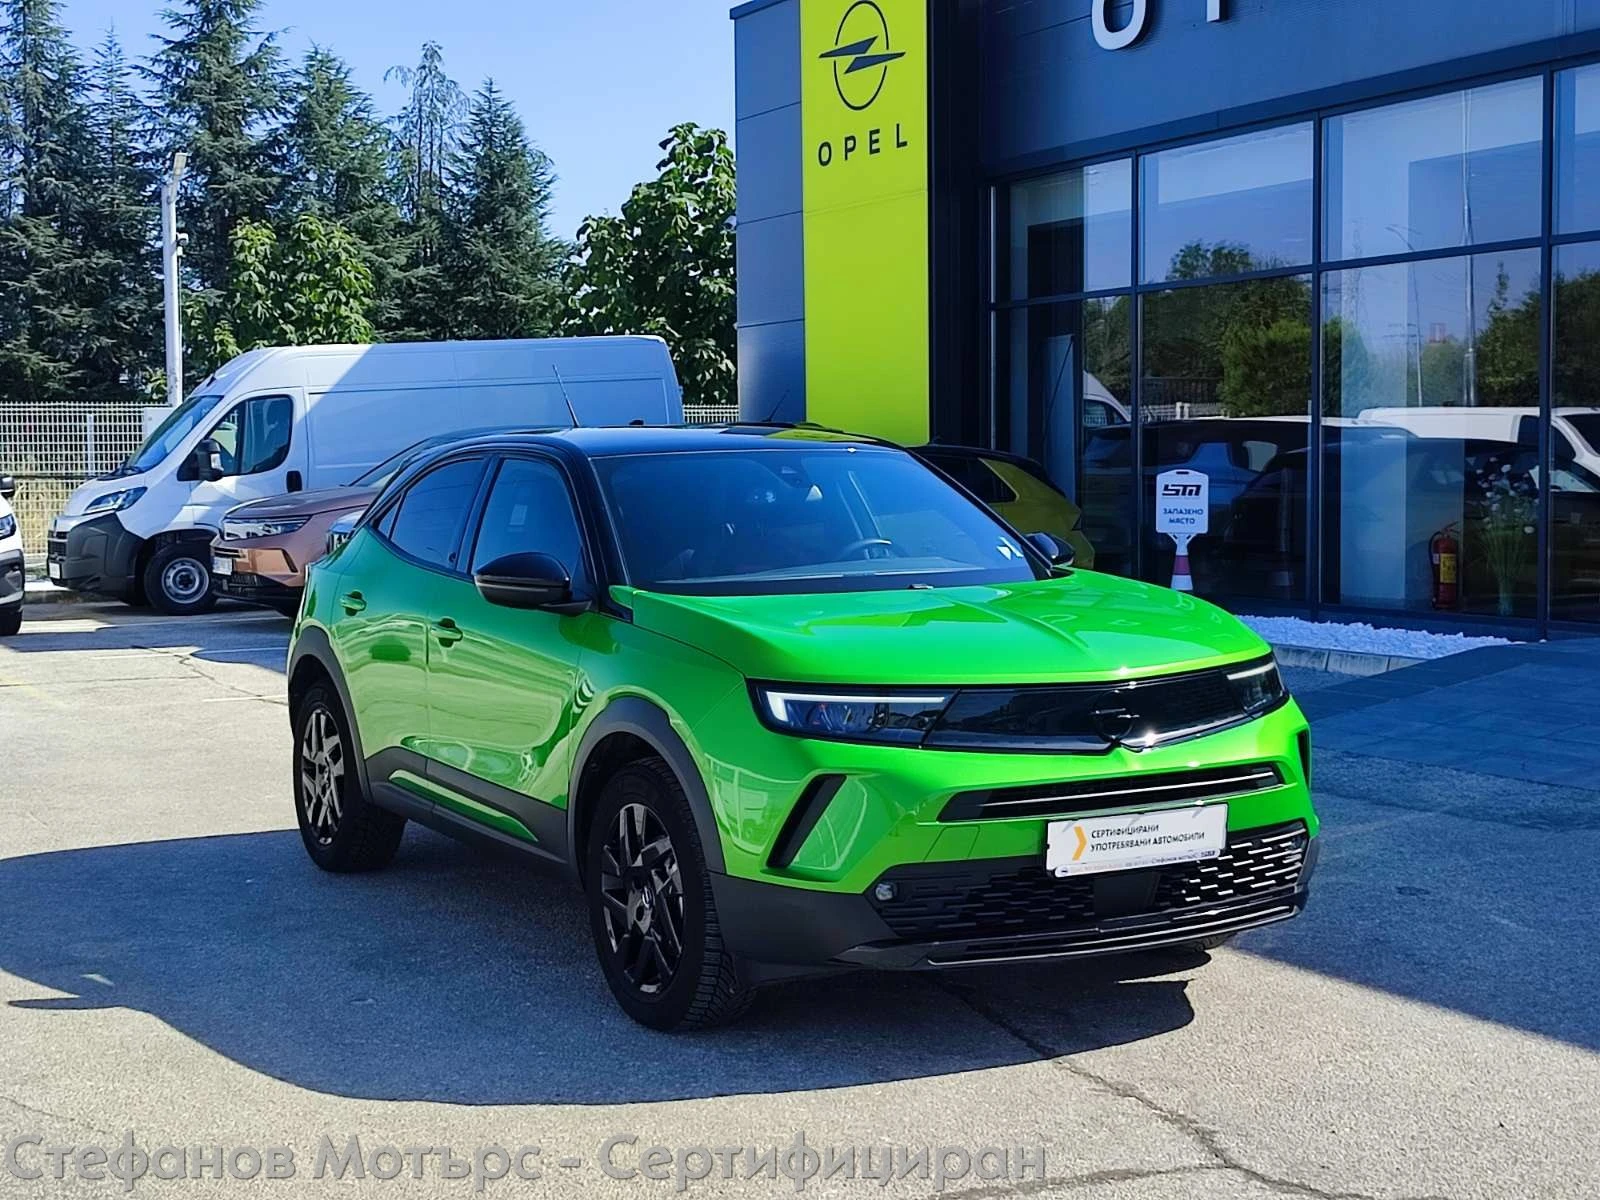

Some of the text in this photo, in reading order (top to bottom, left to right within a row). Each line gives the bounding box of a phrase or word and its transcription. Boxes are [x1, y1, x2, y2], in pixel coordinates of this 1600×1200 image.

[817, 122, 909, 168] OPEL
[1168, 517, 1196, 525] МЯСТО
[1091, 824, 1160, 839] СЕРТИФИЦИРАНИ
[1090, 831, 1206, 852] УПОТРЕБЯВАНИ АВТОМОБИЛИ
